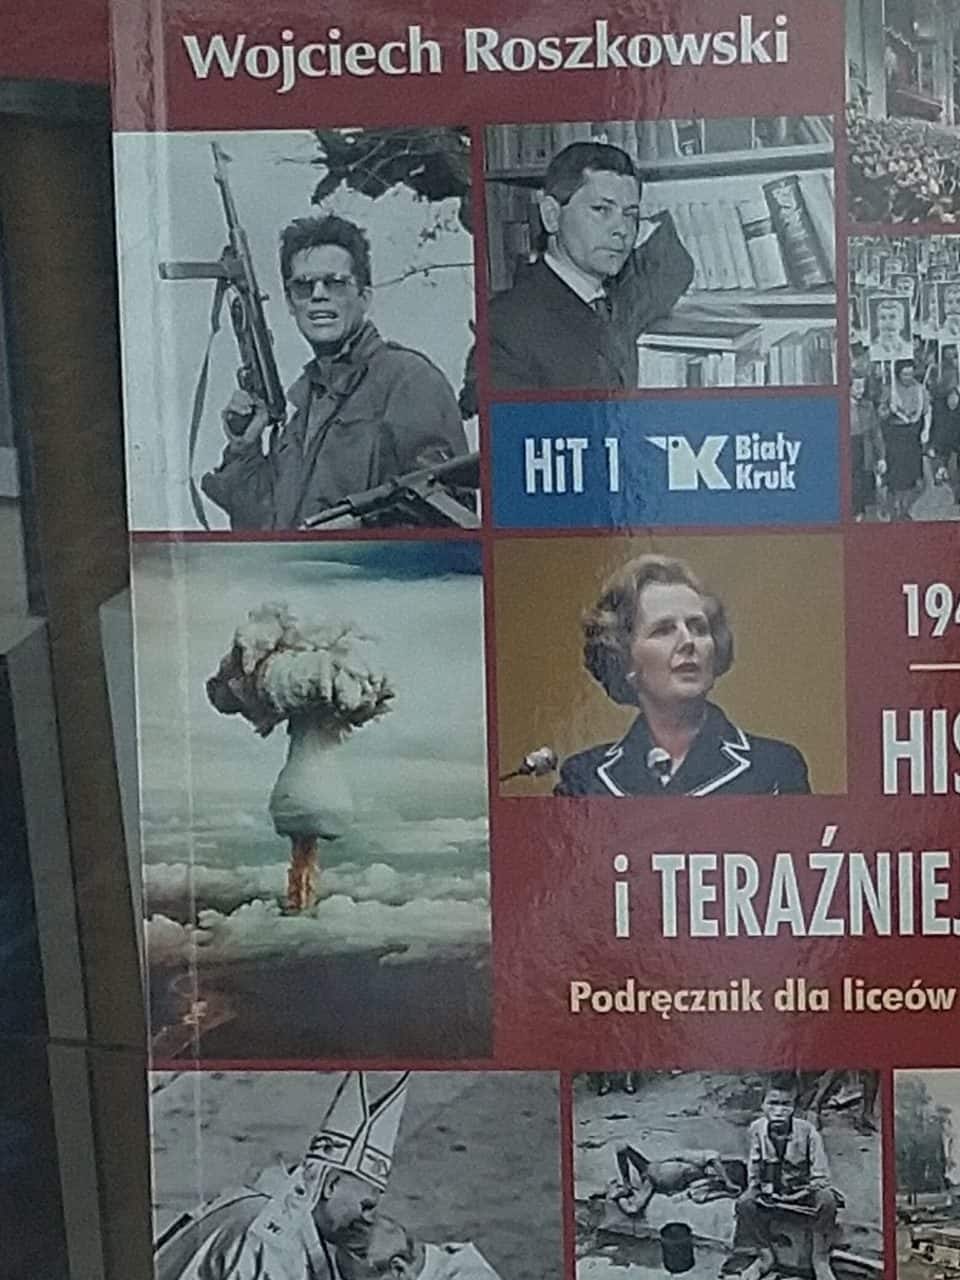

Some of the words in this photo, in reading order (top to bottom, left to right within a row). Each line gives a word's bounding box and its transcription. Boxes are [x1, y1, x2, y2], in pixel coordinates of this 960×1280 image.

[182, 25, 442, 94] Wojciech
[464, 14, 789, 73] Roszkowski
[524, 436, 589, 494] HiT
[603, 436, 620, 493] 1
[735, 432, 802, 465] Biały
[735, 461, 797, 491] Kruk
[613, 853, 631, 939] i
[569, 978, 764, 1021] Podręcznik
[774, 977, 830, 1013] dla
[842, 976, 957, 1012] liceów
